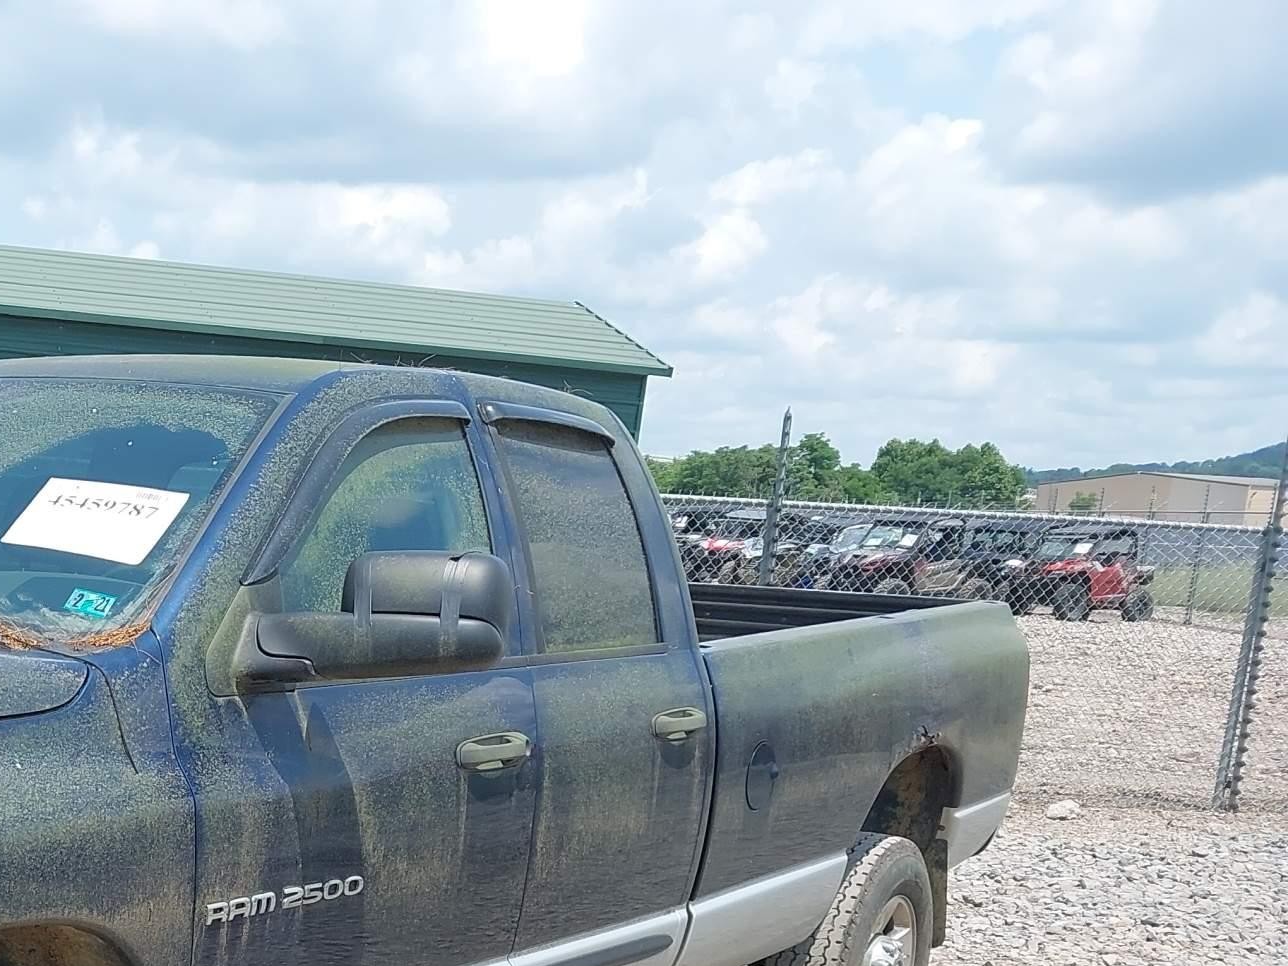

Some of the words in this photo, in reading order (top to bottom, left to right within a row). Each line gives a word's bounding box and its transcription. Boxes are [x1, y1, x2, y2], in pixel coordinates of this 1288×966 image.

[48, 494, 159, 519] 45459787
[94, 597, 110, 612] 21
[205, 891, 276, 926] RAM
[282, 875, 364, 909] 2500
